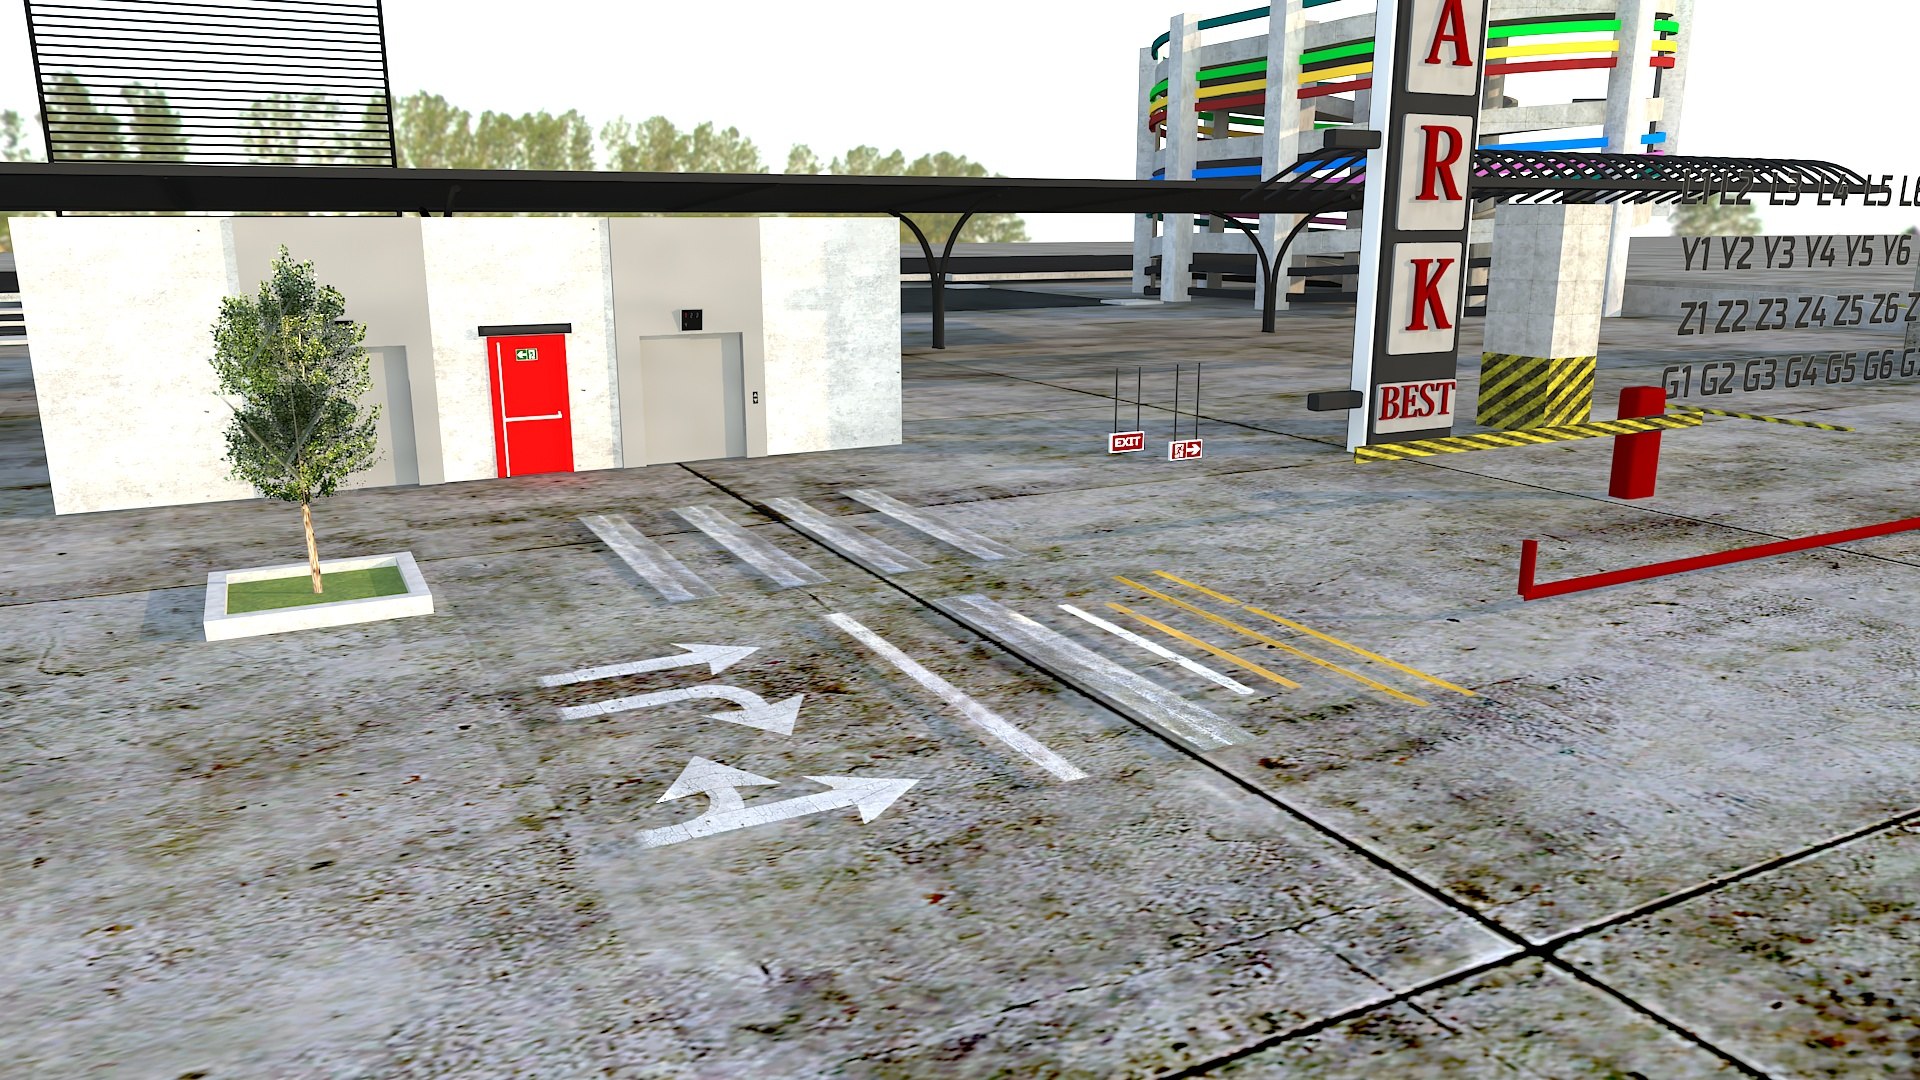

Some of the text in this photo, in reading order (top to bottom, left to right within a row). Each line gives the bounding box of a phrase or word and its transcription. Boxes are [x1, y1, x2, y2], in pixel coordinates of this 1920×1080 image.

[1681, 170, 1711, 205] L1
[1720, 170, 1754, 205] L2
[1769, 172, 1801, 205] L3
[1817, 173, 1848, 206] L4
[1863, 174, 1893, 206] L5
[1682, 235, 1912, 271] Y1 Y2 Y3 Y4 Y5 Y6
[1678, 301, 1708, 335] Z1
[1715, 300, 1749, 333] Z2
[1755, 298, 1788, 330] Z3
[1795, 296, 1826, 328] Z4
[1833, 294, 1864, 325] Z5
[1869, 293, 1899, 323] Z6
[1662, 348, 1920, 399] G1 G2 G3 G4 G5 G6 G
[1379, 382, 1456, 420] BEST
[1114, 436, 1141, 448] EXIT
